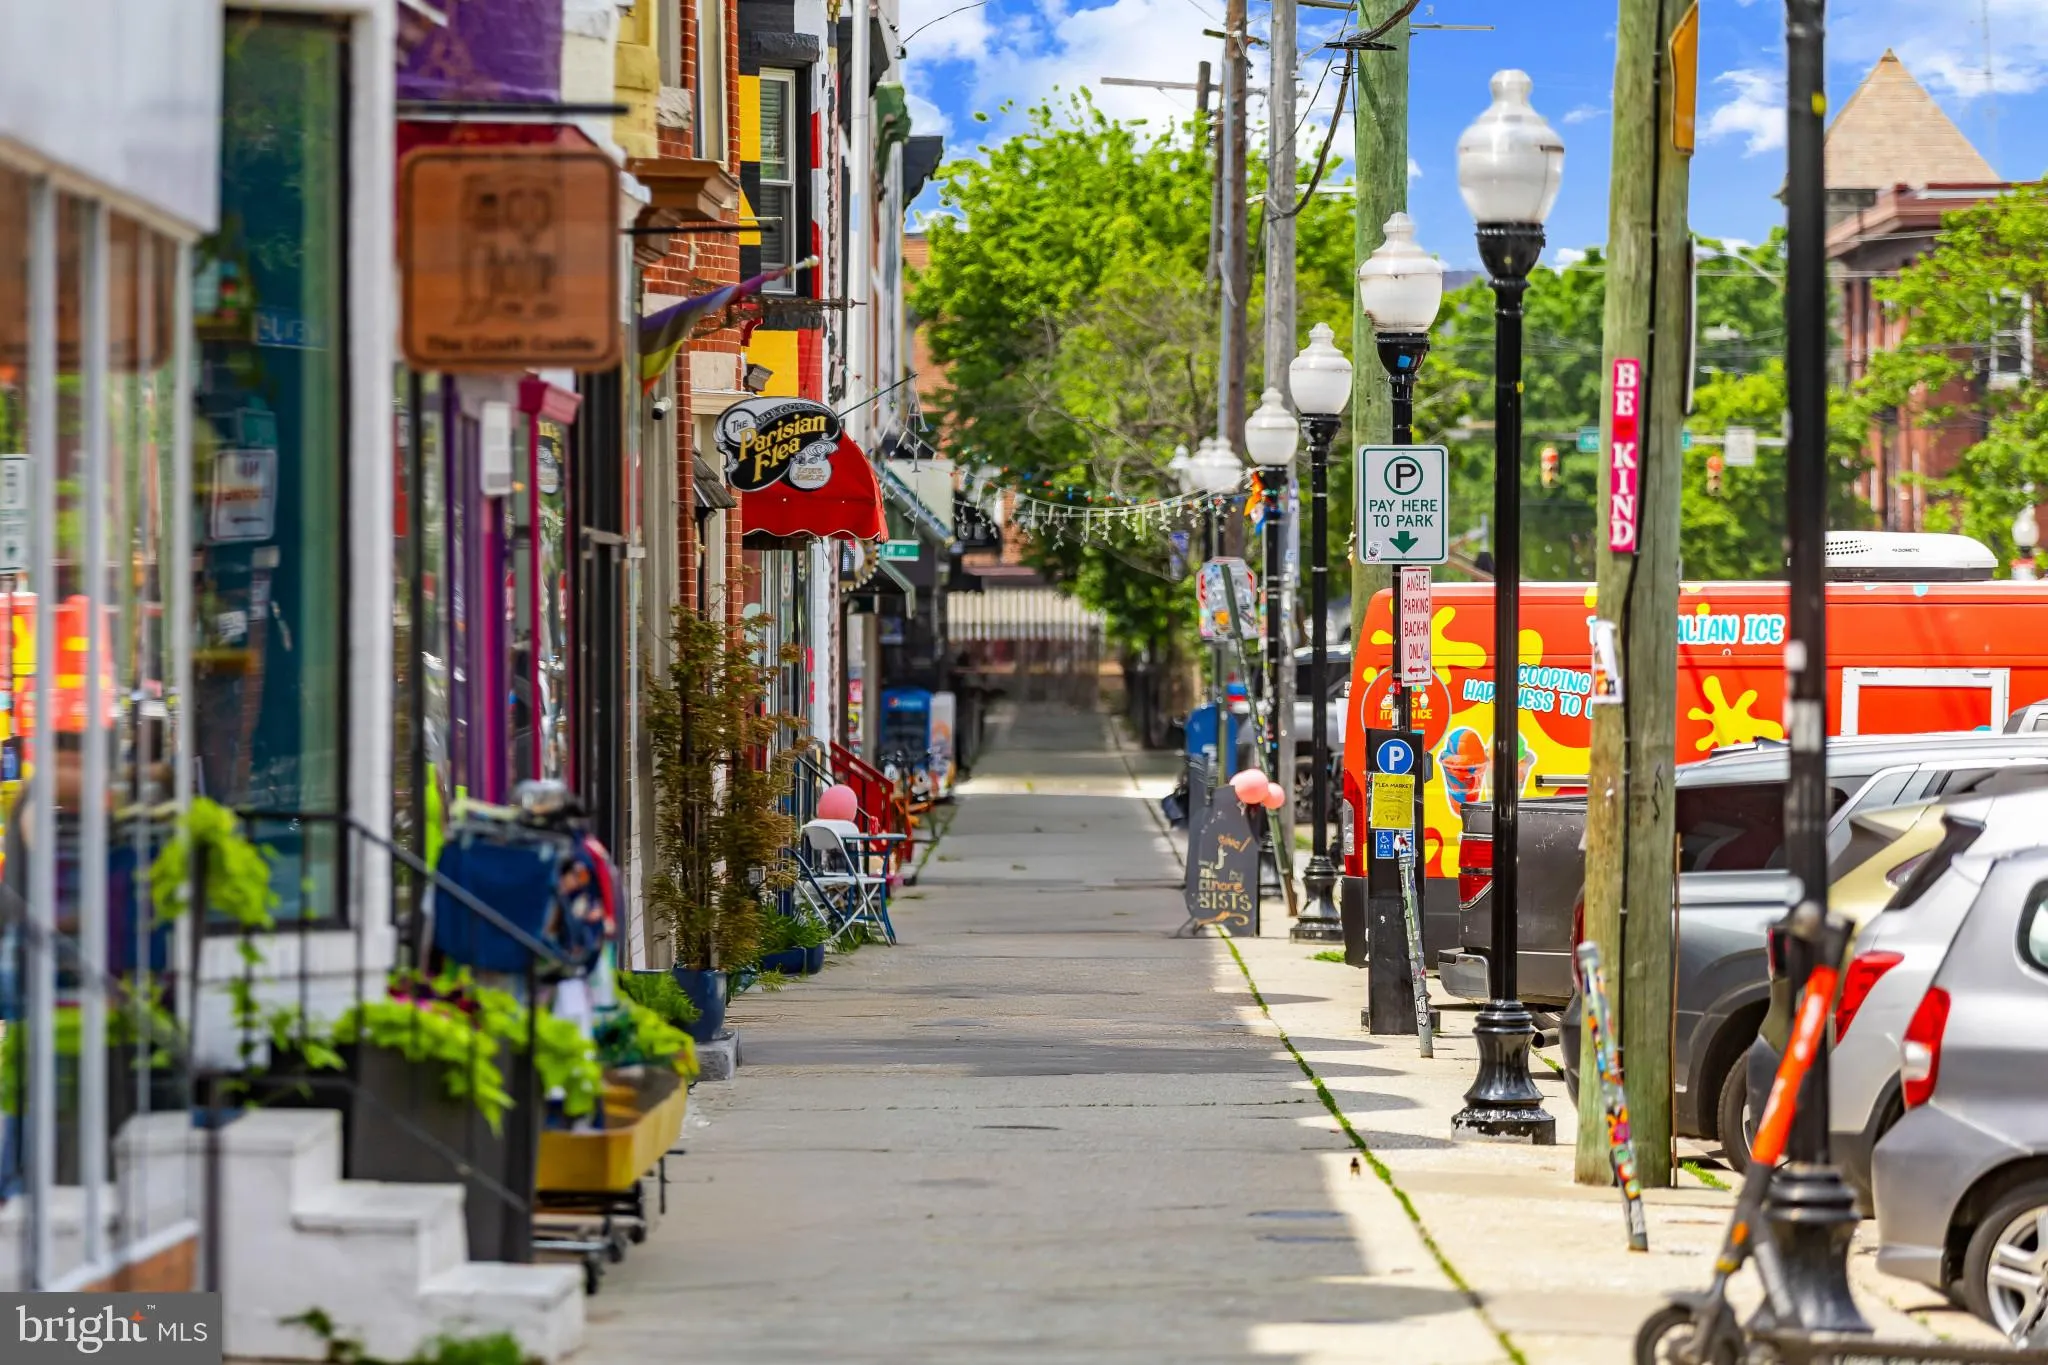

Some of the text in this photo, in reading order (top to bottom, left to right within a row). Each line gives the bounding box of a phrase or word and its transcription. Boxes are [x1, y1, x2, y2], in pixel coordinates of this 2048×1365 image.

[1615, 363, 1636, 416] BE
[739, 413, 827, 462] Parisian
[752, 437, 801, 483] Flea
[1396, 463, 1417, 488] P
[1611, 442, 1636, 546] KIND
[1369, 499, 1438, 512] PAY HERE
[1373, 514, 1434, 527] TO PARK
[1406, 575, 1426, 591] ANGLE
[1404, 599, 1428, 614] PARKING
[1404, 621, 1428, 637] BACK-IN
[1745, 618, 1782, 642] ICE
[1408, 643, 1424, 659] ONLY
[1418, 709, 1432, 719] ICE
[1561, 694, 1580, 715] TO
[1388, 746, 1405, 771] P
